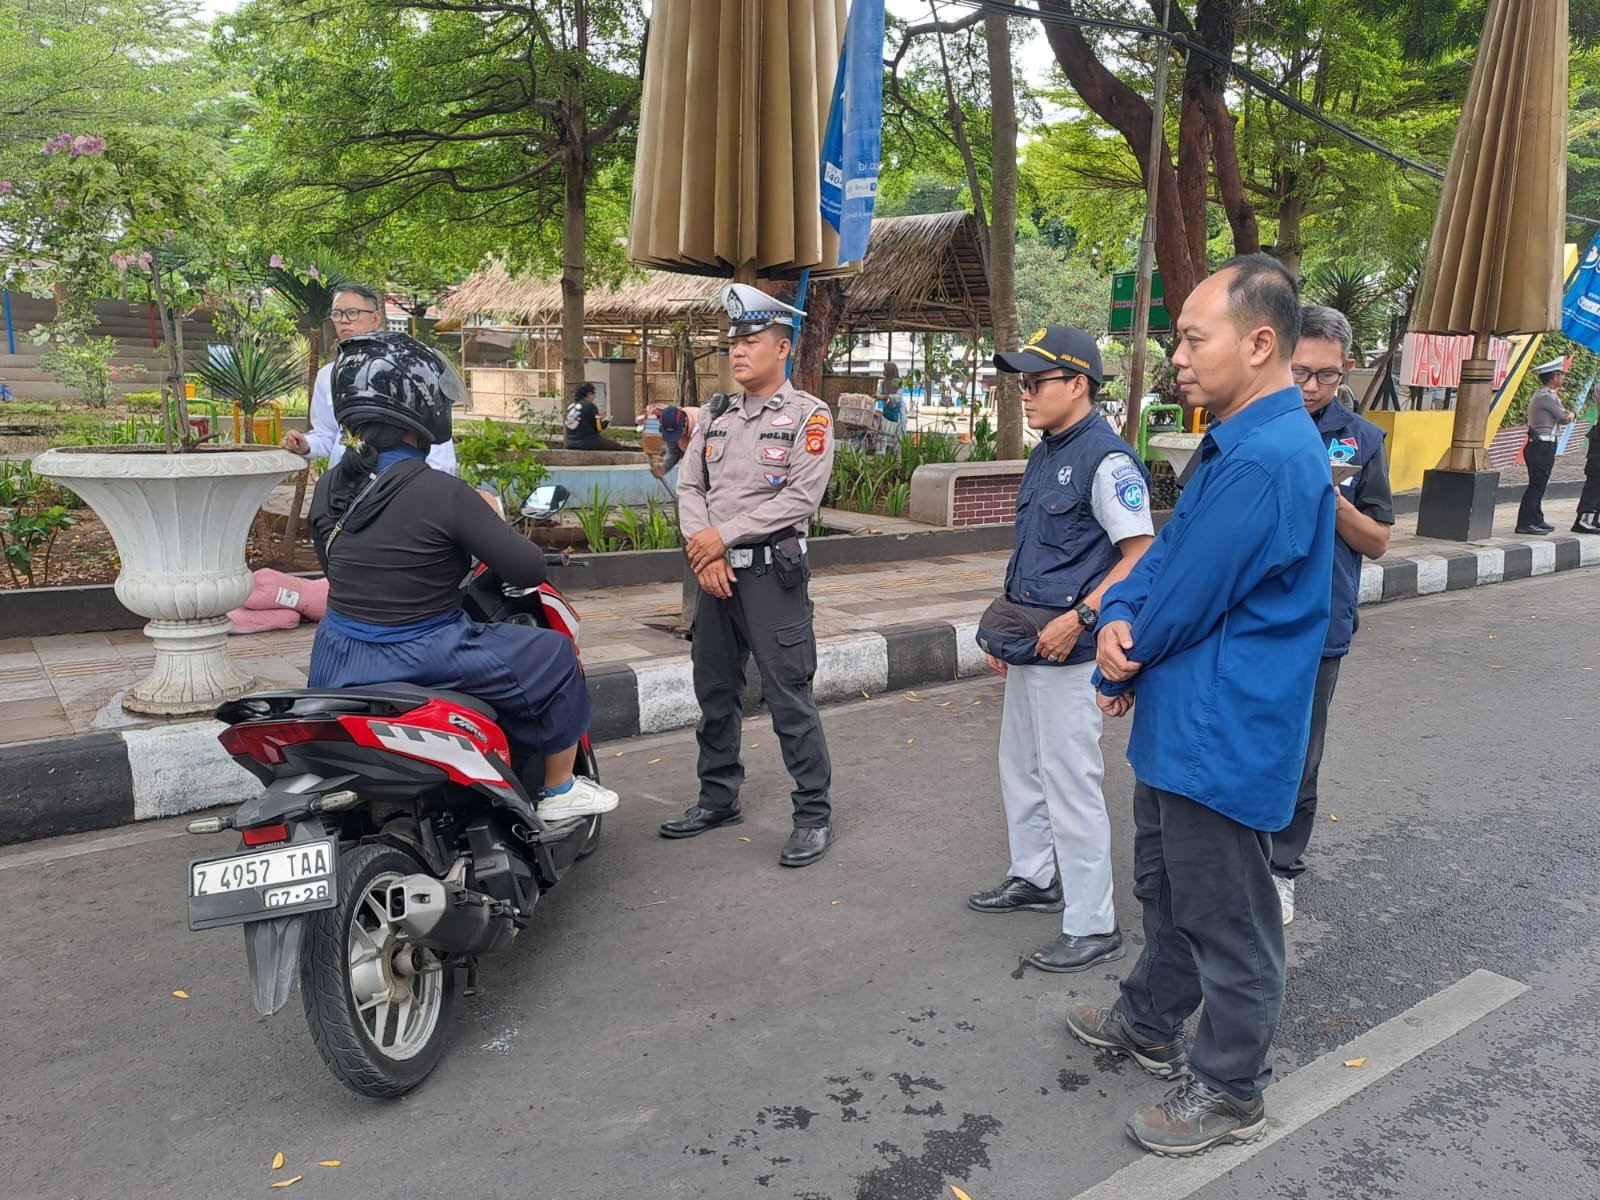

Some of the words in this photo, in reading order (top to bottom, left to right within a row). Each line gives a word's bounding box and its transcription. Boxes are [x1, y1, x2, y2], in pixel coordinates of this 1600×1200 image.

[197, 870, 208, 895] Z
[220, 859, 271, 890] 4957
[286, 849, 327, 878] TAA
